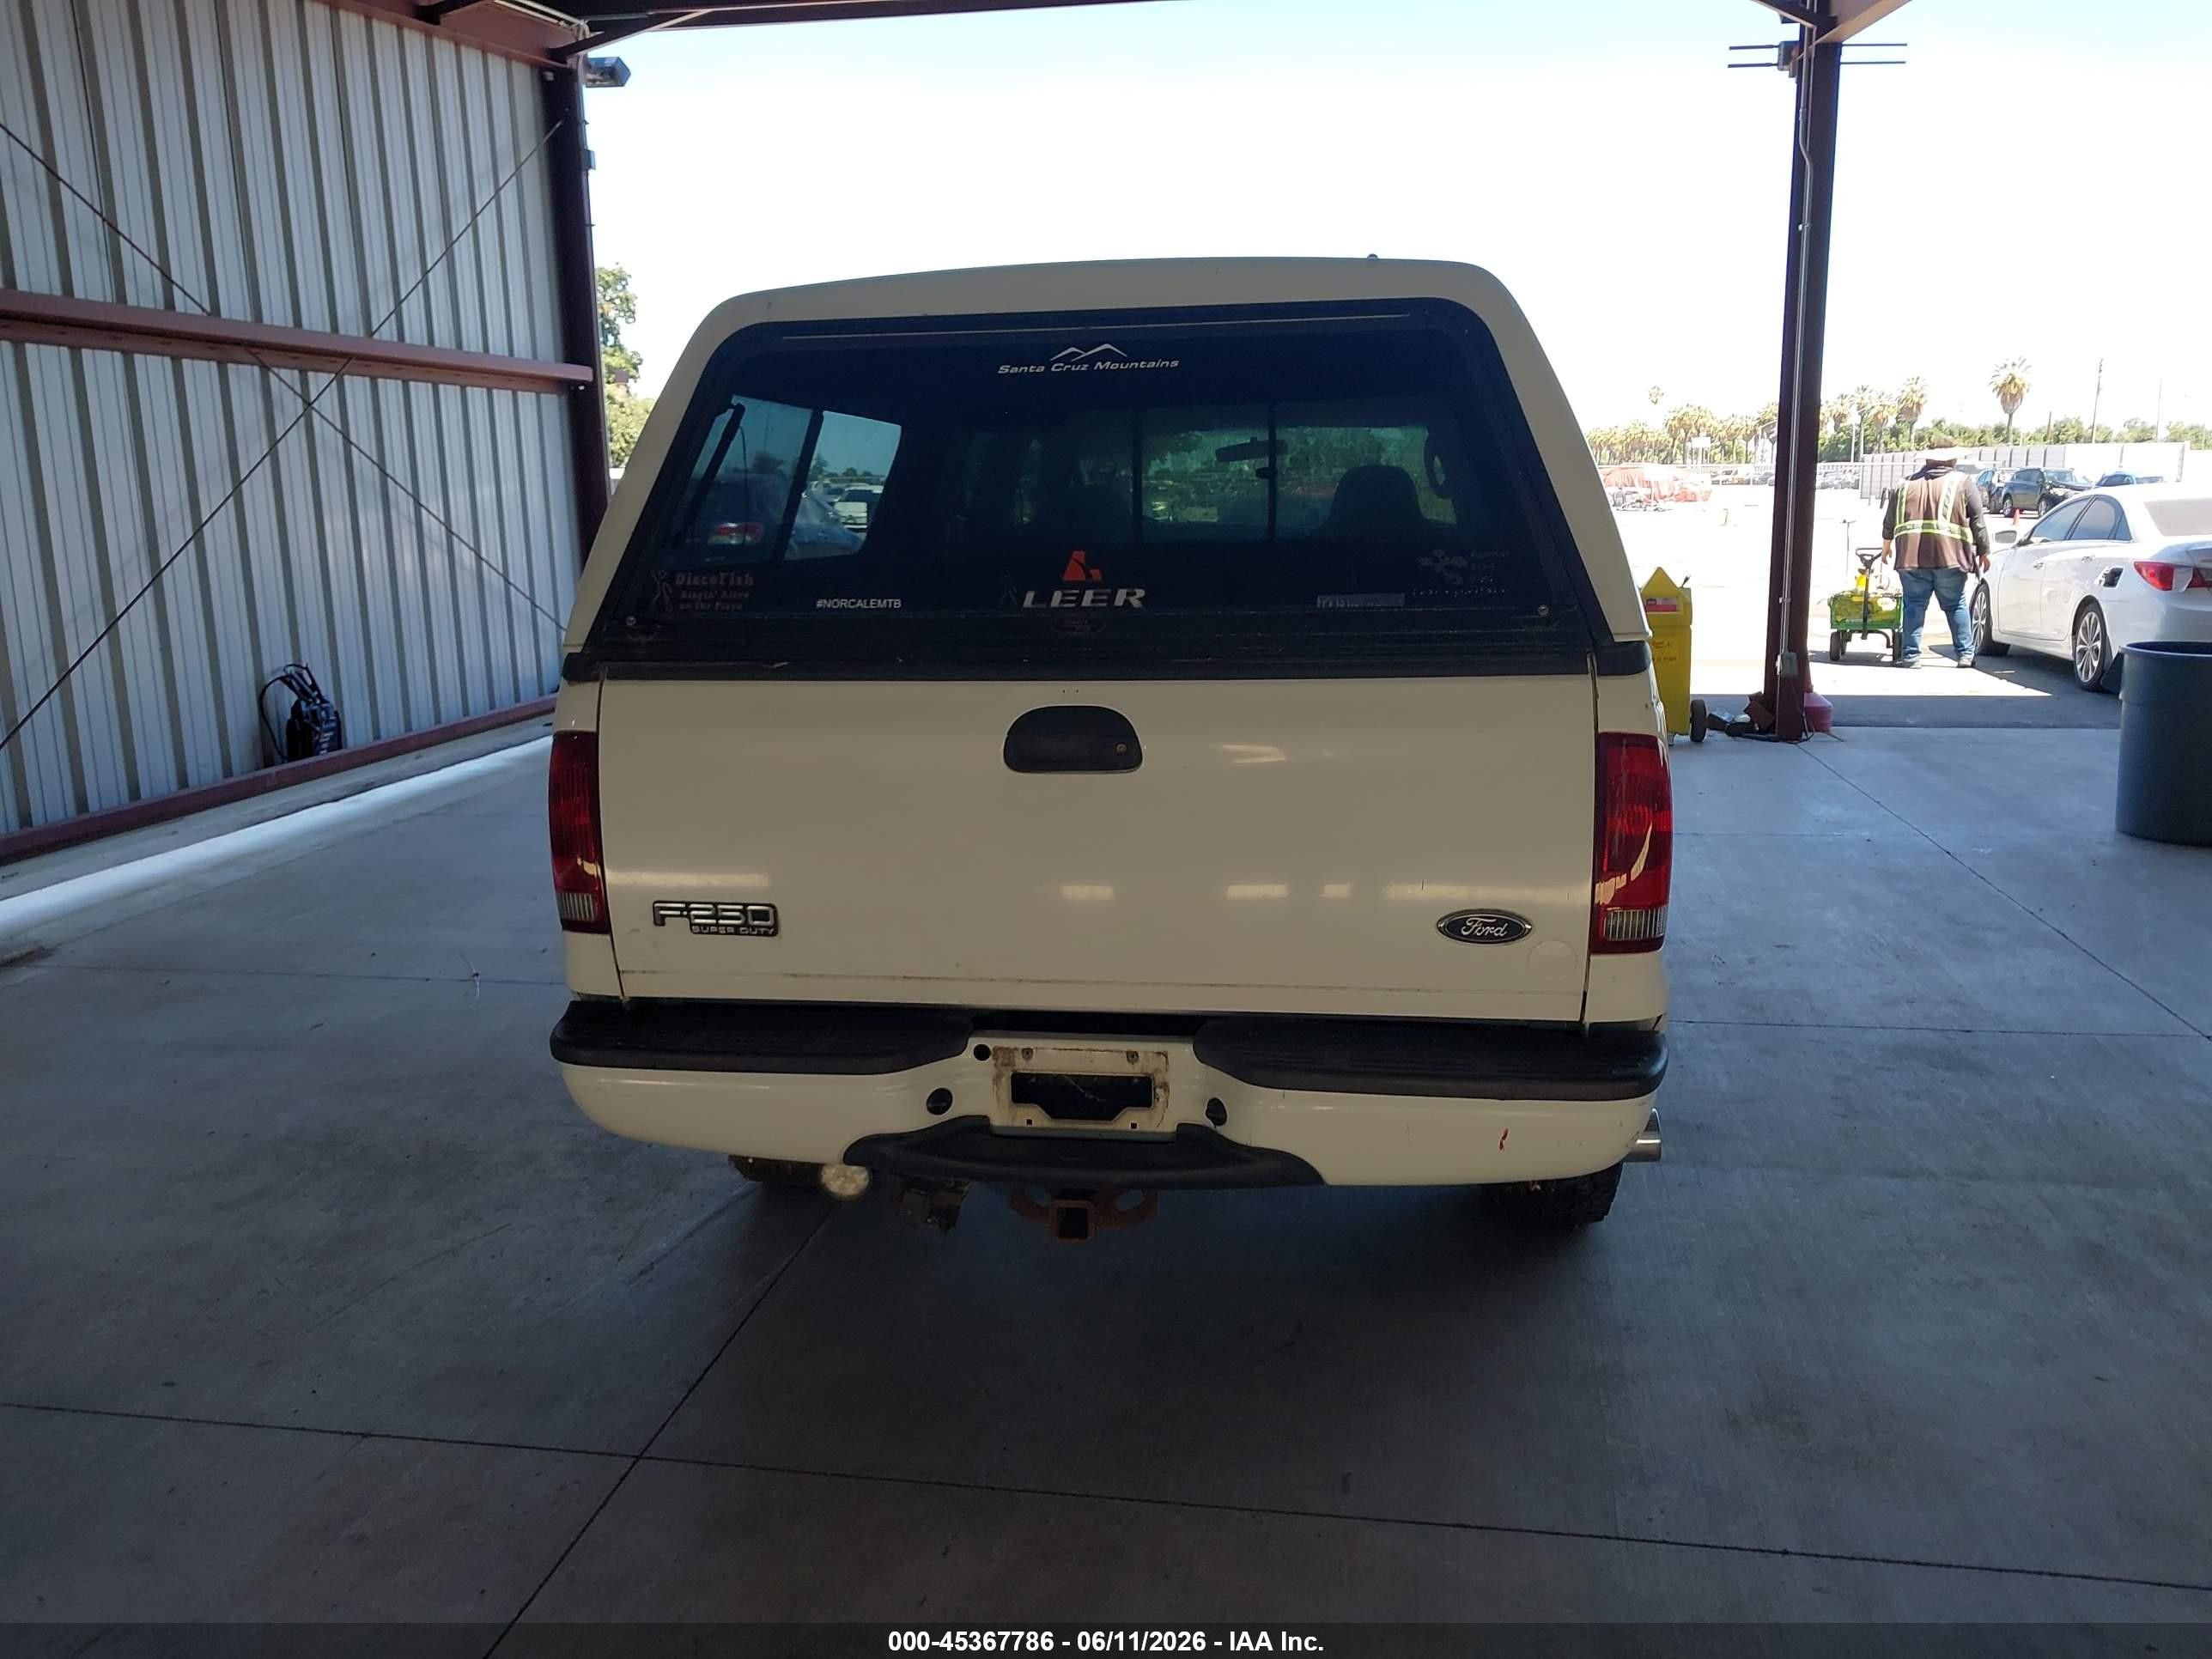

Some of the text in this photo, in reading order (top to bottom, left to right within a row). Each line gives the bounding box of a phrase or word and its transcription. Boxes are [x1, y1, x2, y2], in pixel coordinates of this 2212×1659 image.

[997, 358, 1180, 374] Santa Cruz Mountains
[816, 598, 902, 609] #NORCALEMTB
[1022, 587, 1146, 608] LEER
[691, 926, 775, 935] SUPER DUTY
[1461, 917, 1509, 937] Ford
